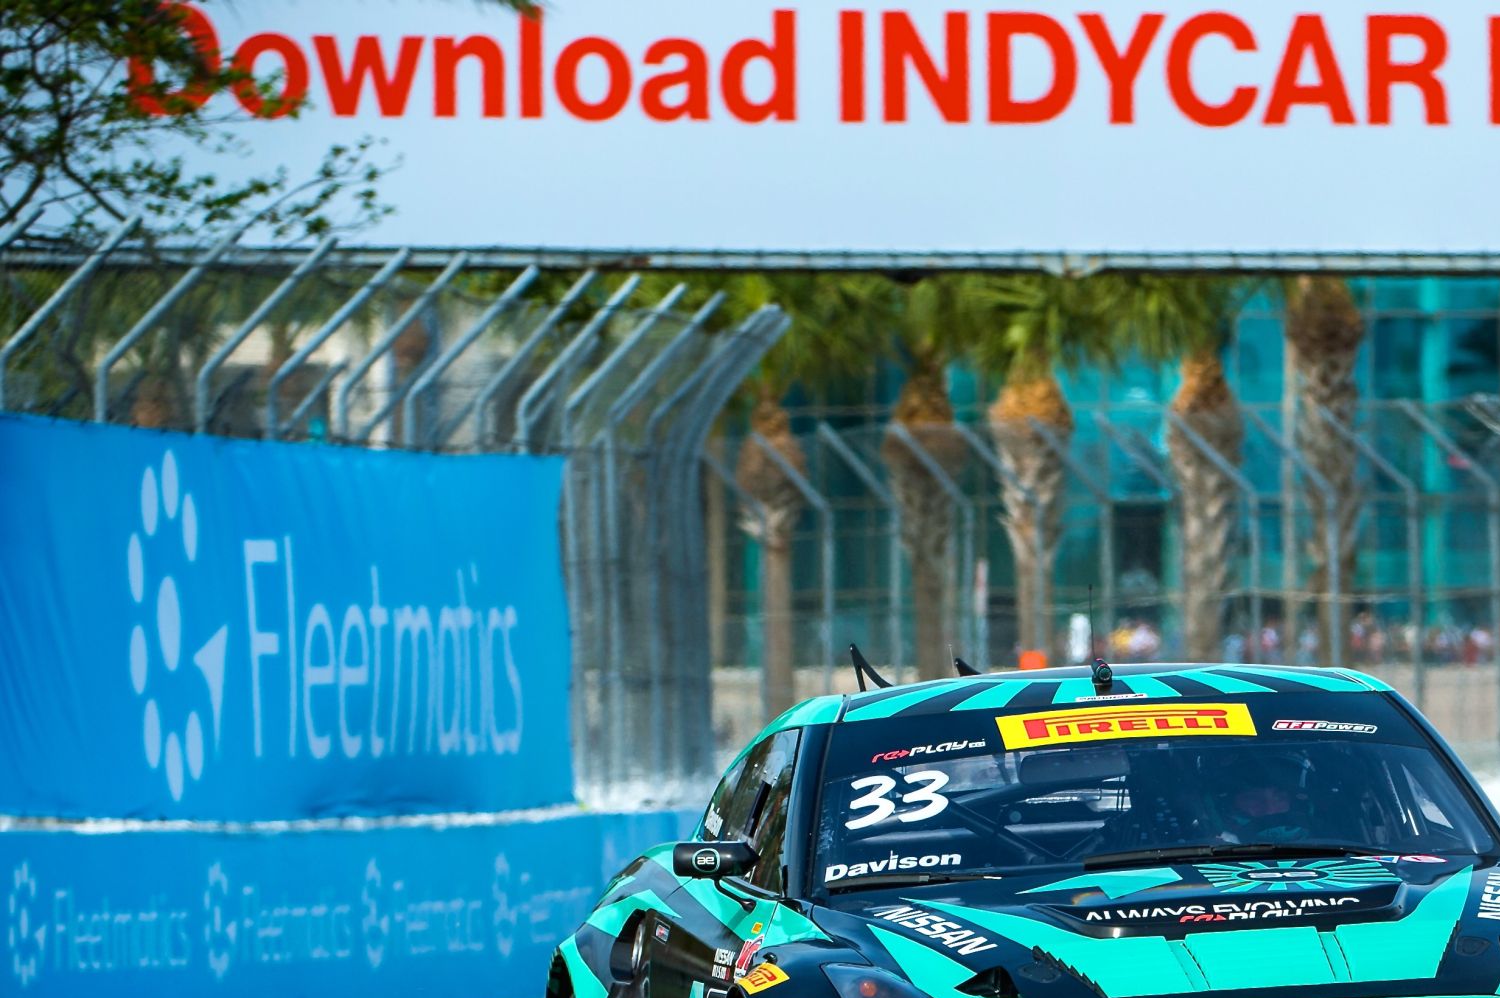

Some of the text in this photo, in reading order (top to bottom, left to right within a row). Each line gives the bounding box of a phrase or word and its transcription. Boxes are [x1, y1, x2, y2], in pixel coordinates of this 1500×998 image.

[128, 0, 797, 122] Download
[839, 9, 1450, 128] INDYCAR
[244, 535, 523, 759] Fleetmatics
[1022, 708, 1230, 740] PIRELLI
[845, 770, 949, 830] 33
[825, 851, 961, 882] Davison
[874, 904, 998, 956] NISSAN
